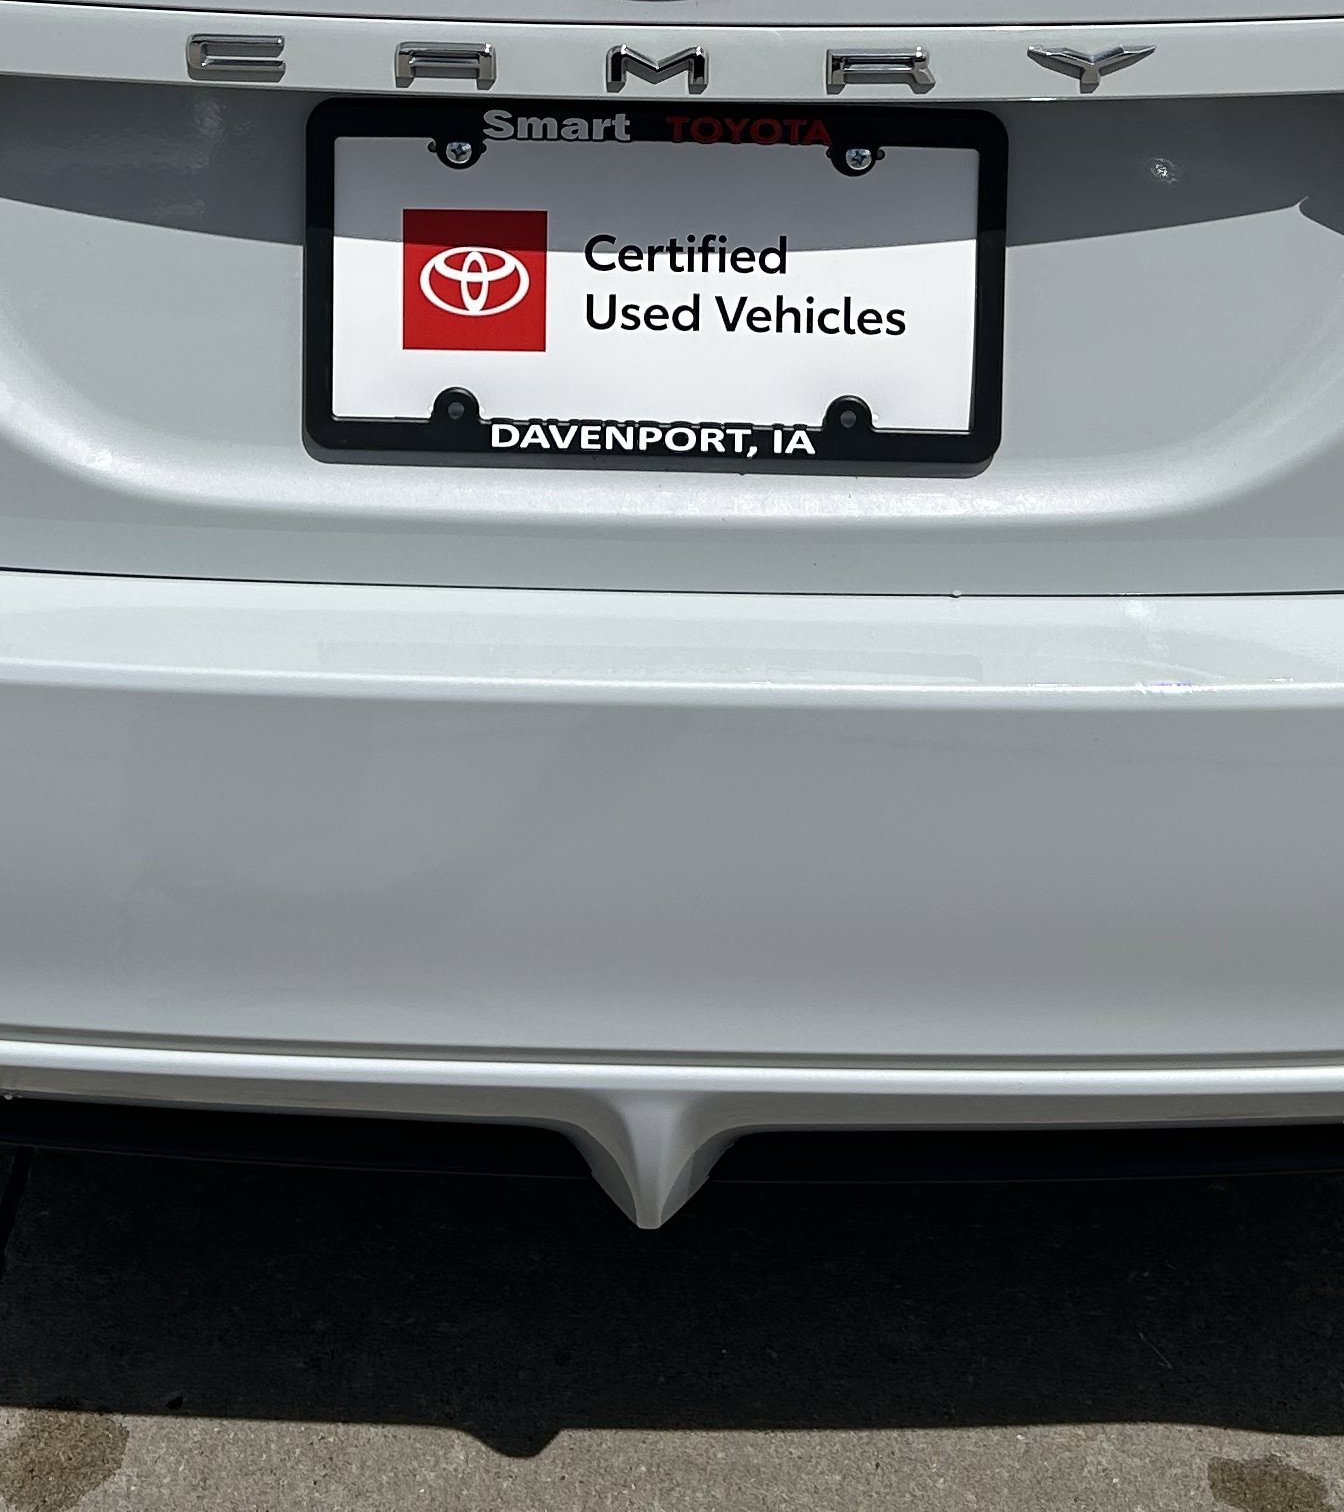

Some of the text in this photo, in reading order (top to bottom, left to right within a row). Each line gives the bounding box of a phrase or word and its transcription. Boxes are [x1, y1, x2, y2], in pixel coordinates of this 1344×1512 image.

[186, 32, 1158, 93] CAMRY
[482, 109, 833, 146] Smart TOYOTA
[584, 234, 788, 276] Certified
[584, 294, 907, 336] Used Vehicles
[490, 423, 817, 458] DAVENPORT, IA
